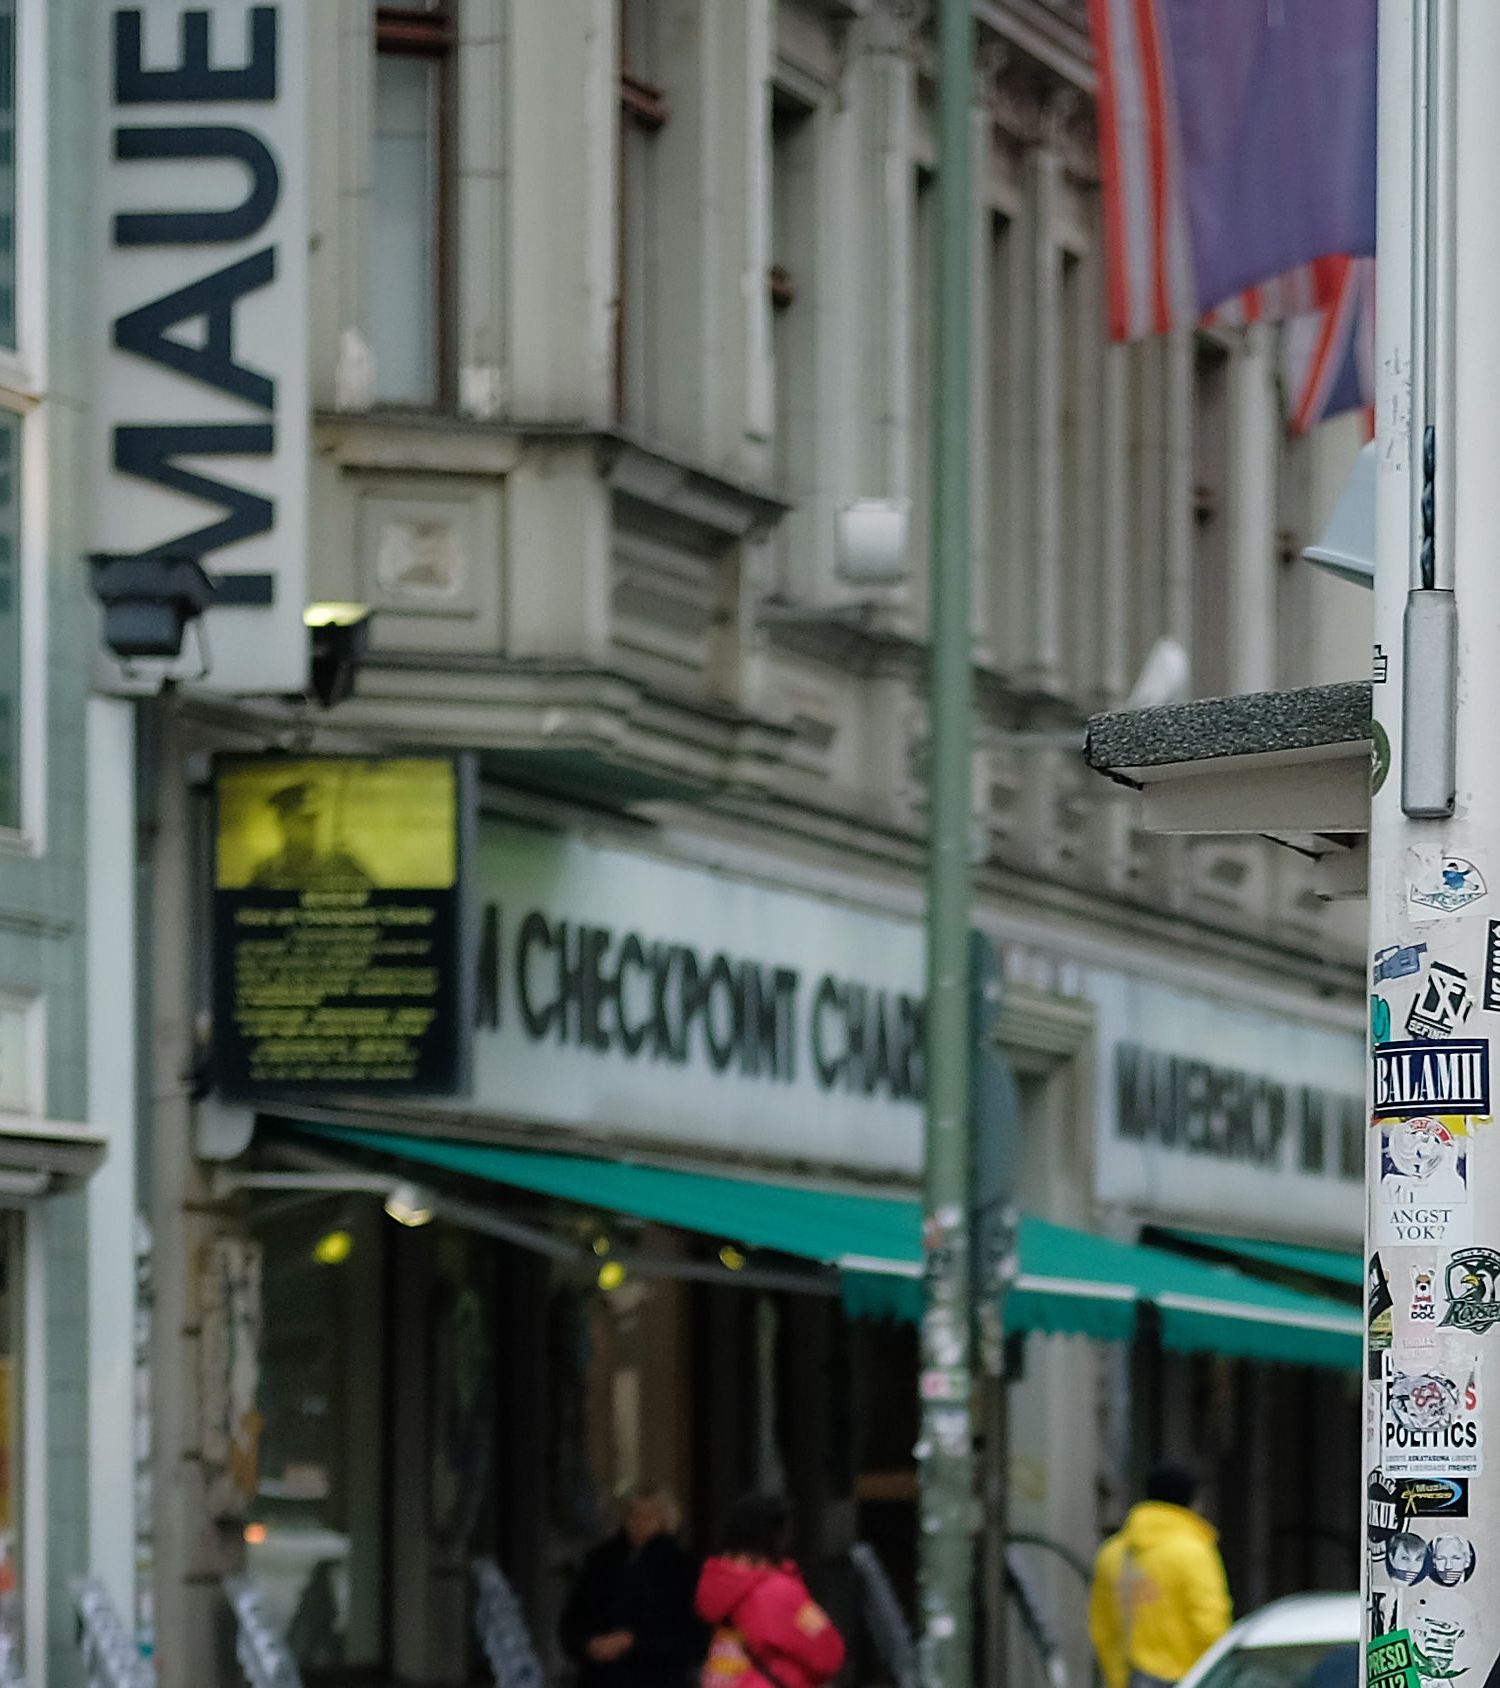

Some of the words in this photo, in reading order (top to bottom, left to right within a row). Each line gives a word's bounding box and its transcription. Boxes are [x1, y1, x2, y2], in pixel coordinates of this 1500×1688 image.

[517, 911, 797, 1084] CHECKPOINT
[1375, 1052, 1483, 1105] BALAMII
[1390, 1208, 1452, 1224] ANGST
[1396, 1225, 1446, 1240] YOK?
[1411, 1312, 1435, 1320] DOG
[1419, 1304, 1435, 1312] MY
[1386, 1421, 1477, 1448] POLITICS
